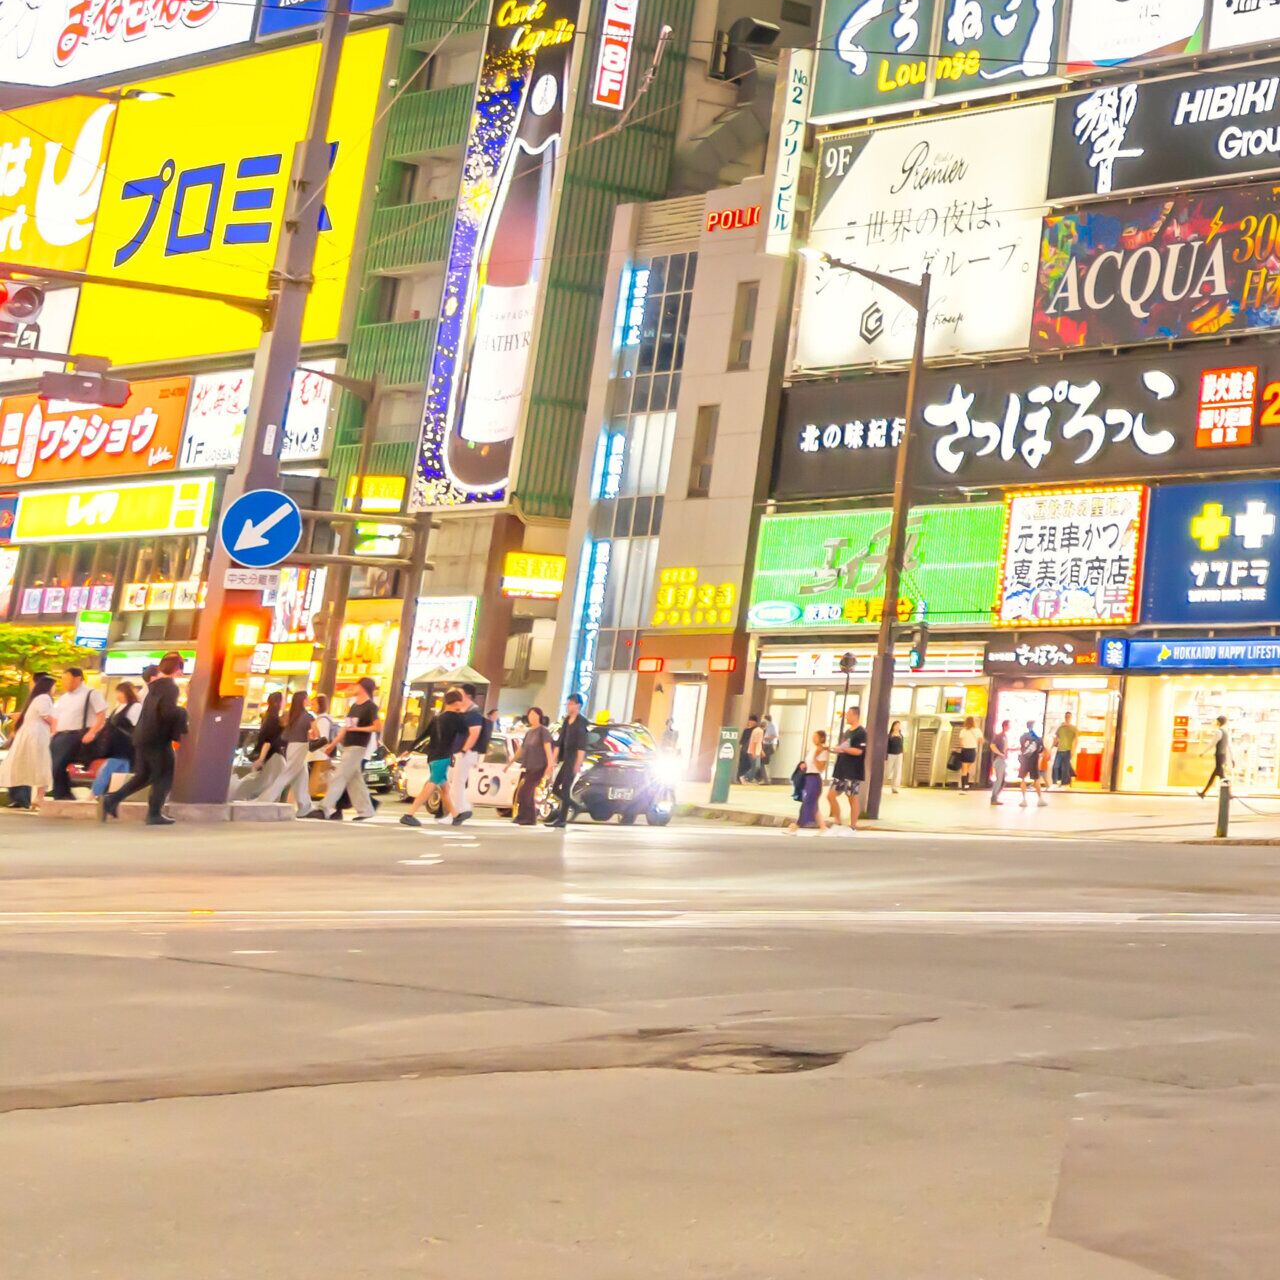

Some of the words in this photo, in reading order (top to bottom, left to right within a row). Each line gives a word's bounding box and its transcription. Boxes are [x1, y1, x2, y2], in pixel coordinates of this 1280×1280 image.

[600, 44, 630, 98] 8F
[877, 49, 981, 92] Lounge
[1075, 84, 1144, 194] 響
[1174, 78, 1280, 125] HIBIKI
[825, 146, 852, 178] 9F
[890, 141, 969, 193] Premier
[1046, 239, 1229, 319] ACQUA
[40, 407, 158, 461] ワタショウ
[923, 370, 1175, 472] さっぽろっこ
[186, 434, 205, 463] 1F
[1014, 522, 1119, 553] 元祖串かつ
[1010, 555, 1129, 588] 恵美須商店
[1190, 560, 1270, 586] サツドラ
[1174, 645, 1216, 659] HOKKAIDO
[1219, 645, 1246, 659] HAPPY
